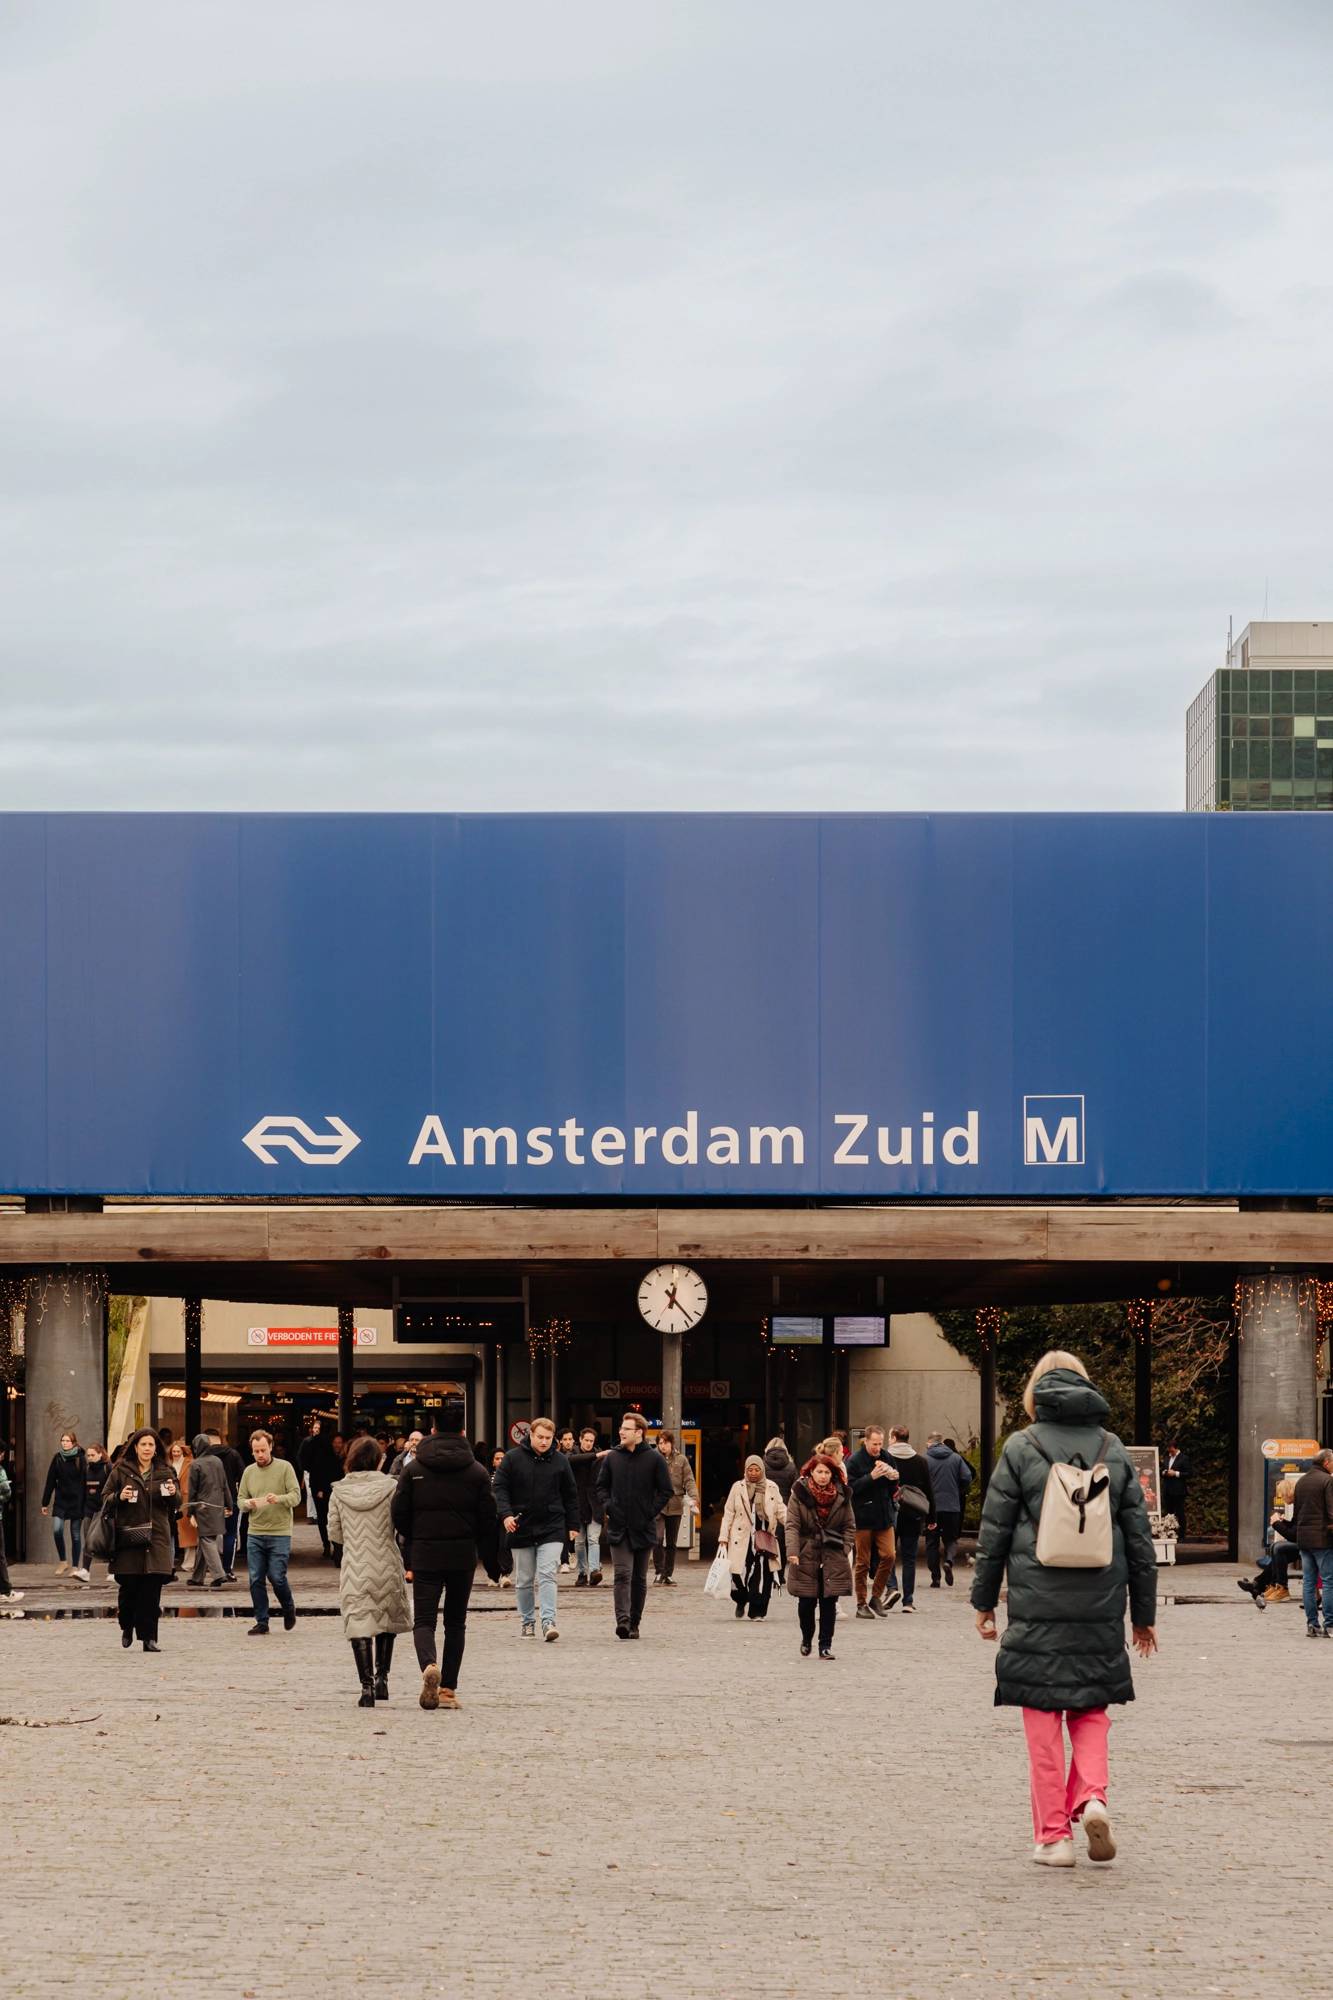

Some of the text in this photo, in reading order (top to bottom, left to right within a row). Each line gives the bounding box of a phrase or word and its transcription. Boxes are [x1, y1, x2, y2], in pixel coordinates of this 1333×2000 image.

[408, 1110, 979, 1165] Amsterdam Zuid
[1026, 1116, 1077, 1163] M
[267, 1332, 310, 1341] VERBODEN
[313, 1332, 322, 1341] TE
[684, 1385, 710, 1394] ETSEN
